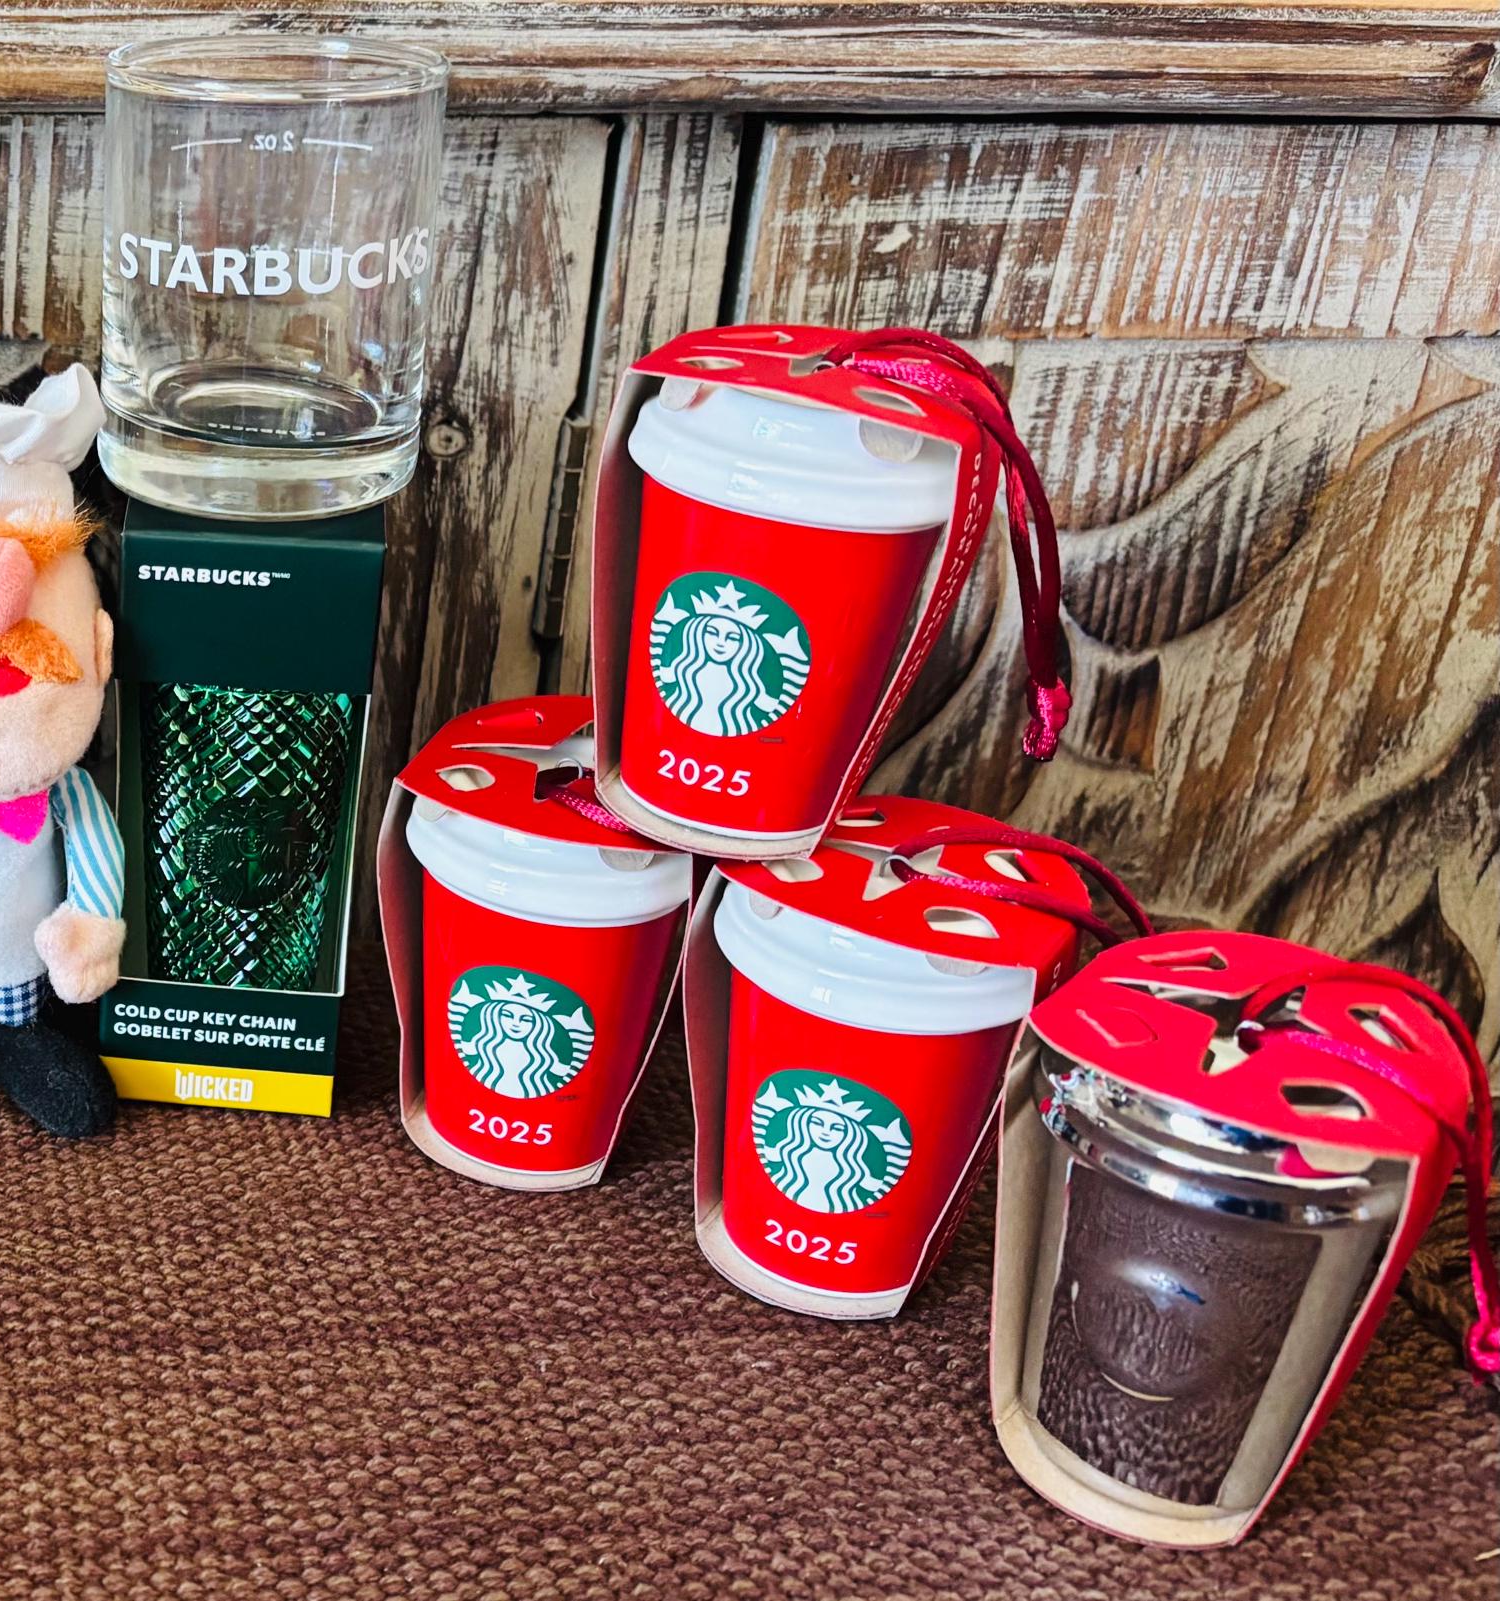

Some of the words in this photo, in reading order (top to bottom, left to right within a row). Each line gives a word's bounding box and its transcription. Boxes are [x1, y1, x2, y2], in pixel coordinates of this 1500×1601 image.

[119, 226, 429, 296] STARBUCKS
[138, 564, 270, 587] STARBUCKS
[657, 749, 751, 796] 2025
[114, 1003, 161, 1020] COLD
[164, 1008, 199, 1023] CUP
[202, 1012, 236, 1026] KEY
[239, 1014, 297, 1031] CHAIN
[113, 1021, 191, 1041] GOBELET
[194, 1029, 229, 1045] SUR
[233, 1032, 290, 1050] PORTE
[294, 1037, 325, 1052] CLÉ
[175, 1067, 254, 1103] WICKED
[469, 1108, 553, 1145] 2025
[764, 1219, 858, 1264] 2025
